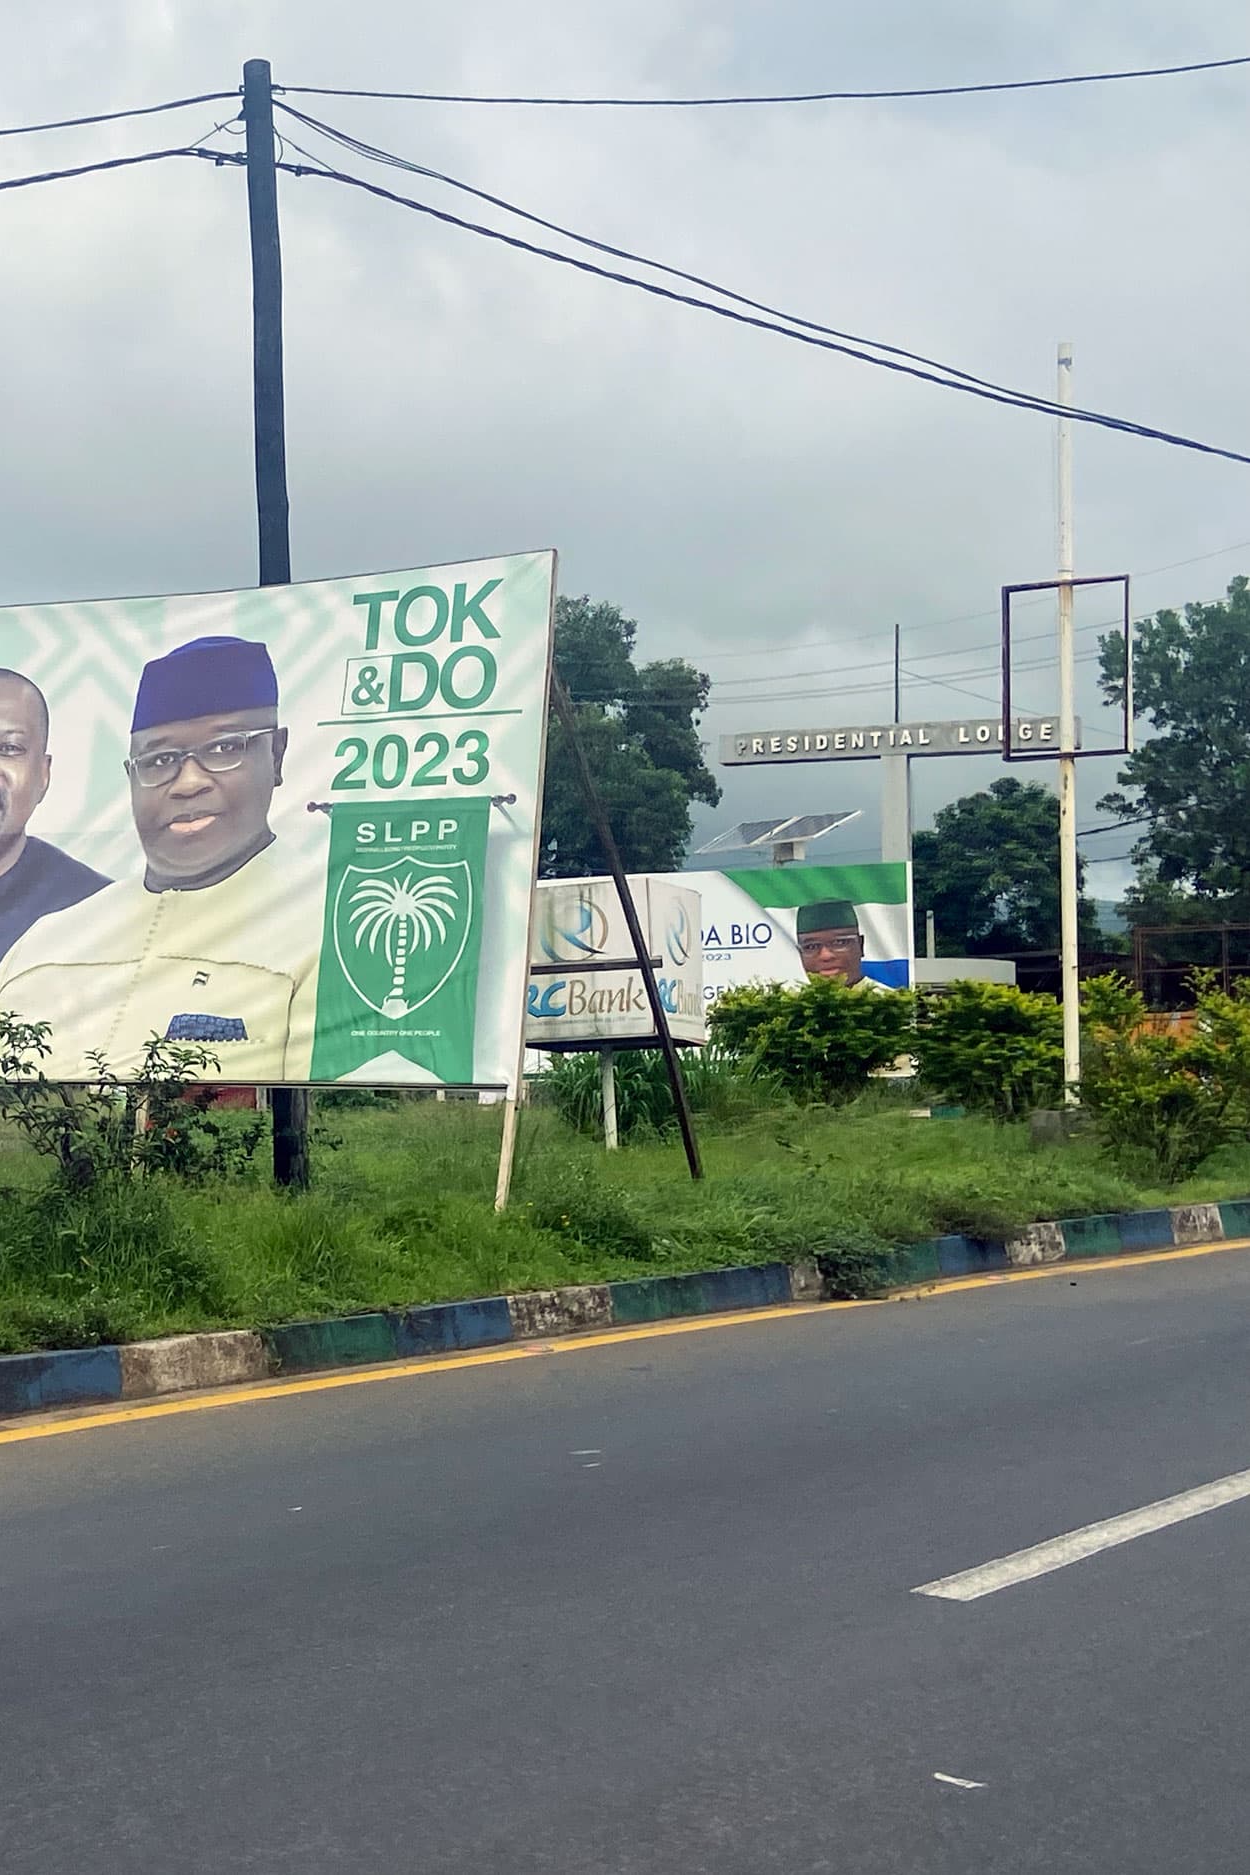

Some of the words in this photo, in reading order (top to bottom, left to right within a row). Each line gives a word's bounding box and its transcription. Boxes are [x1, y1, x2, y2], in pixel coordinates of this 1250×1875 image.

[353, 578, 504, 650] TOK
[736, 727, 931, 756] PRESIDENTIAL
[331, 730, 490, 790] 2023
[356, 819, 458, 843] SLPP
[701, 924, 722, 946] A
[731, 922, 772, 944] BIO
[702, 952, 732, 961] 023
